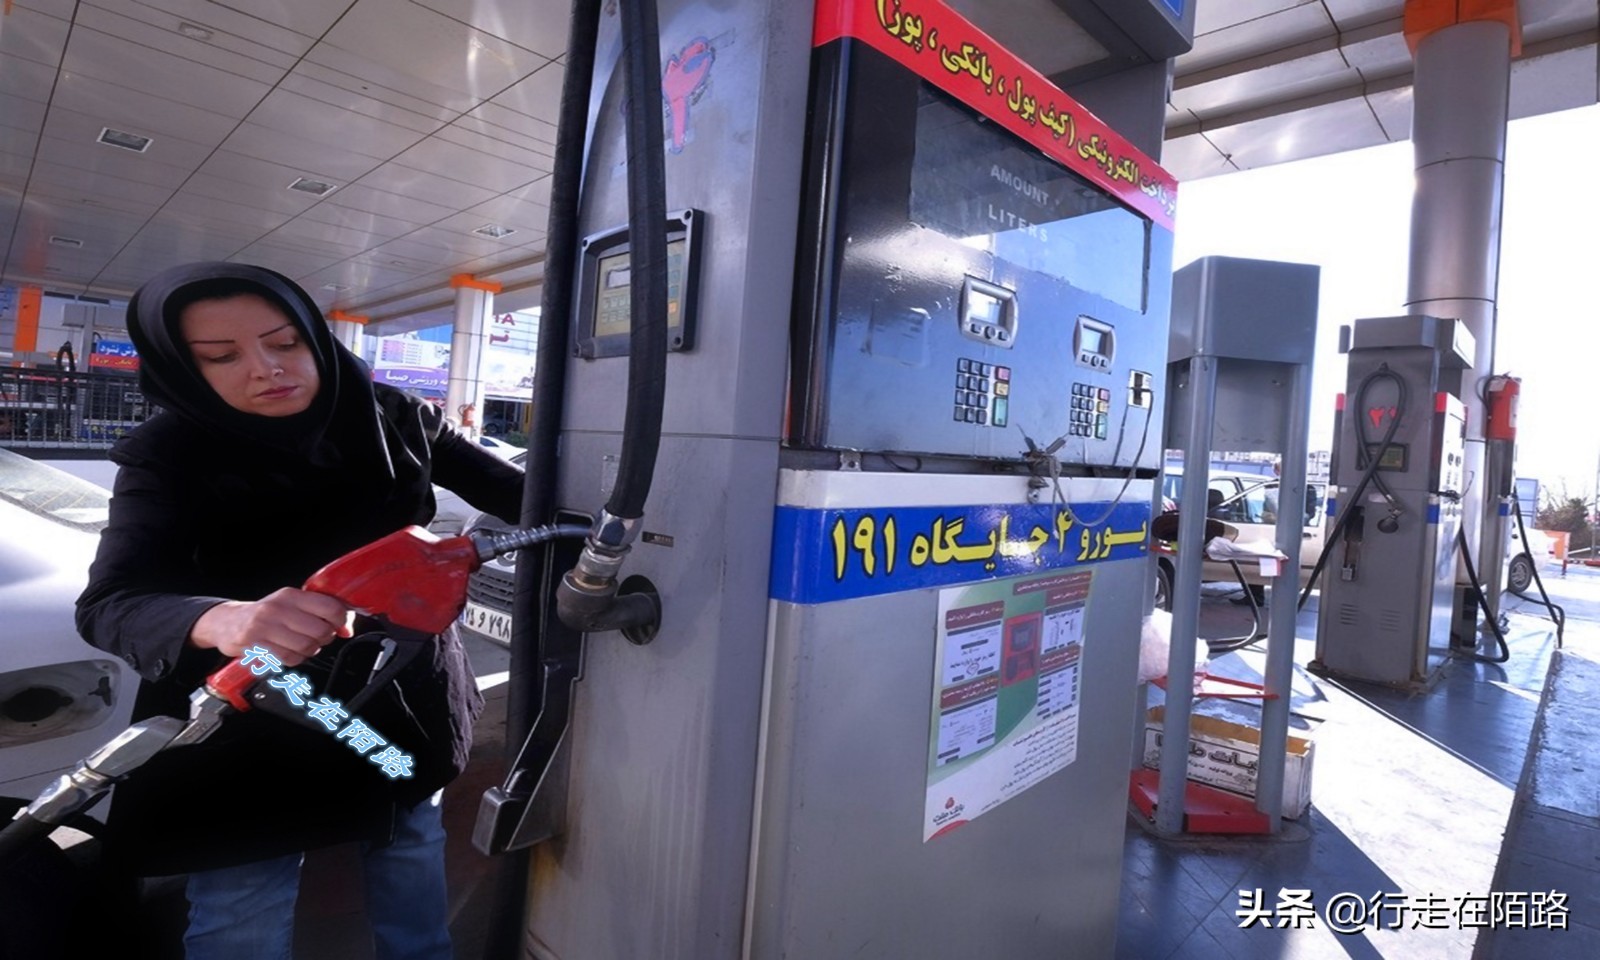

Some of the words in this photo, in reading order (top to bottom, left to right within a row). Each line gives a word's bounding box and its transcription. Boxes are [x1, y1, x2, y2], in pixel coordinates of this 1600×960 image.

[1077, 136, 1140, 185] الکترونیکی
[991, 164, 1049, 206] AMOUNT
[988, 204, 1048, 242] LITERS
[385, 369, 409, 383] صبا
[831, 514, 897, 584] ۱۹۱
[909, 512, 1050, 572] جایگاه
[1076, 519, 1149, 562] یورو
